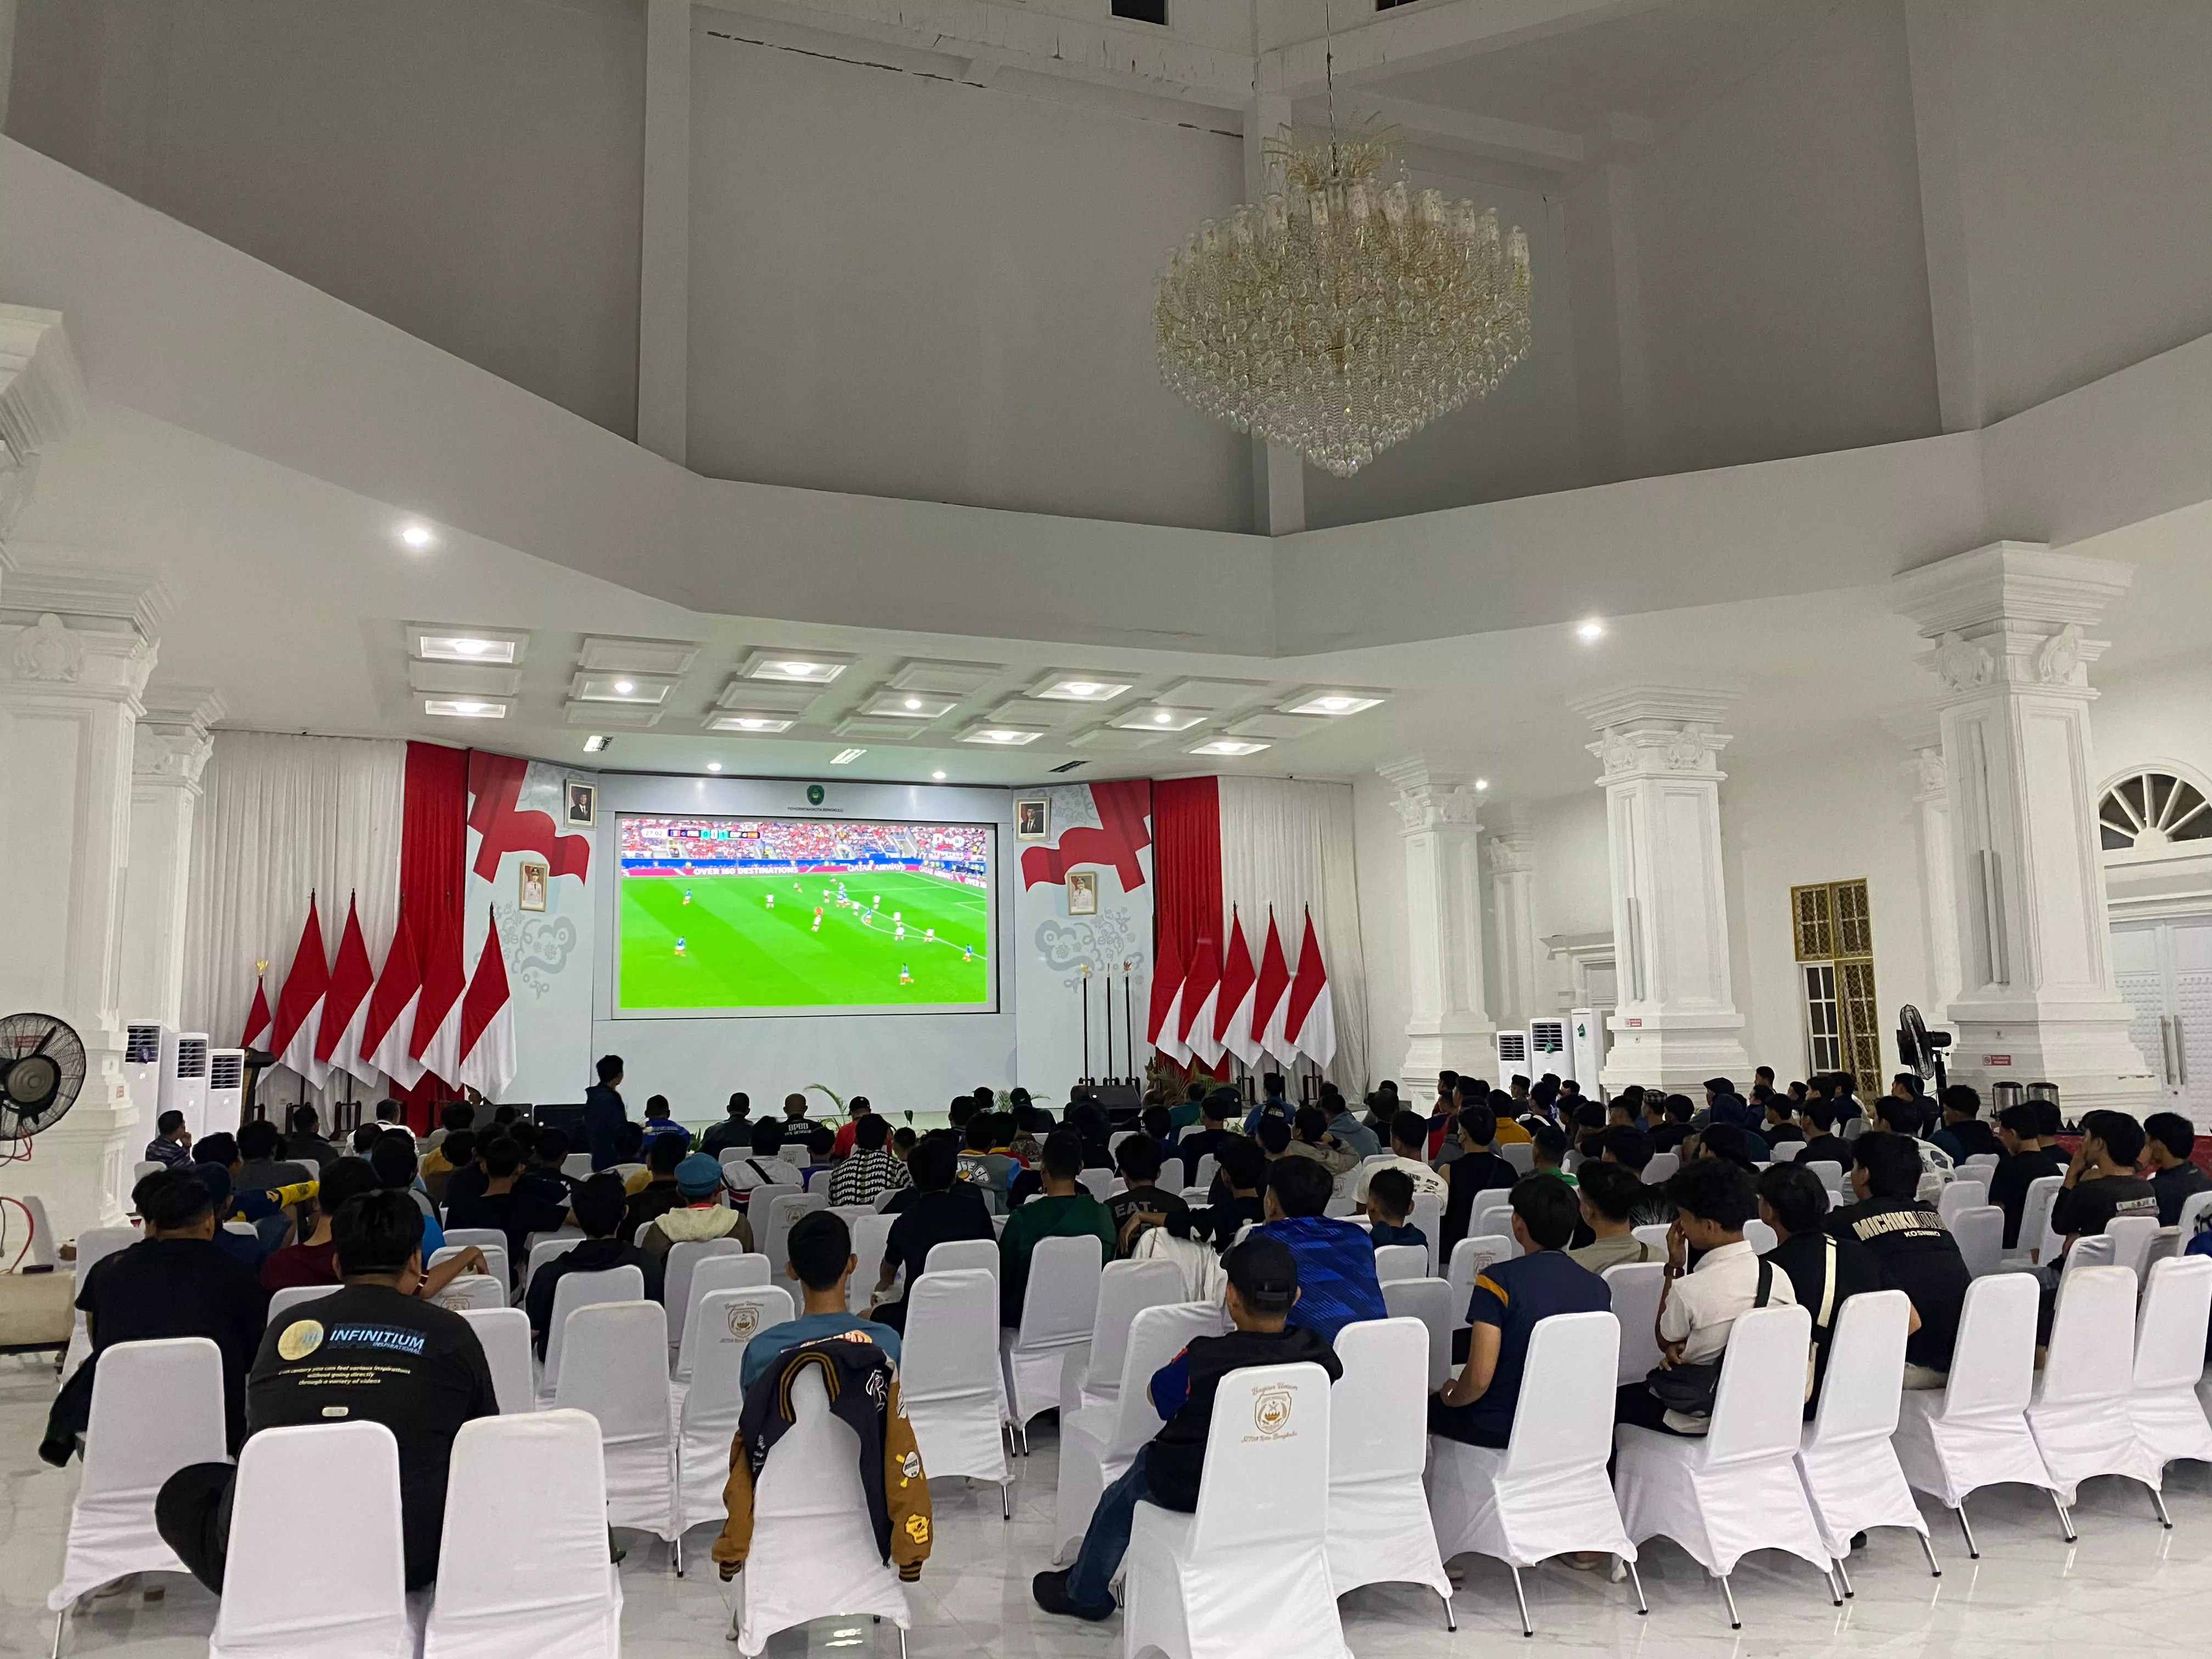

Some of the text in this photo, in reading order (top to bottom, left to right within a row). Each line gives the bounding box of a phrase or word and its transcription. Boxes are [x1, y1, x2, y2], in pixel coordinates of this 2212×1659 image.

[737, 866, 799, 874] DESTINATIONS
[873, 862, 906, 871] AIRWAYS
[1852, 1211, 1920, 1242] MICHIKO
[329, 1329, 425, 1350] INFINITIUM
[372, 1341, 422, 1355] INSPIRATIONAL
[1251, 1385, 1276, 1396] Bagian
